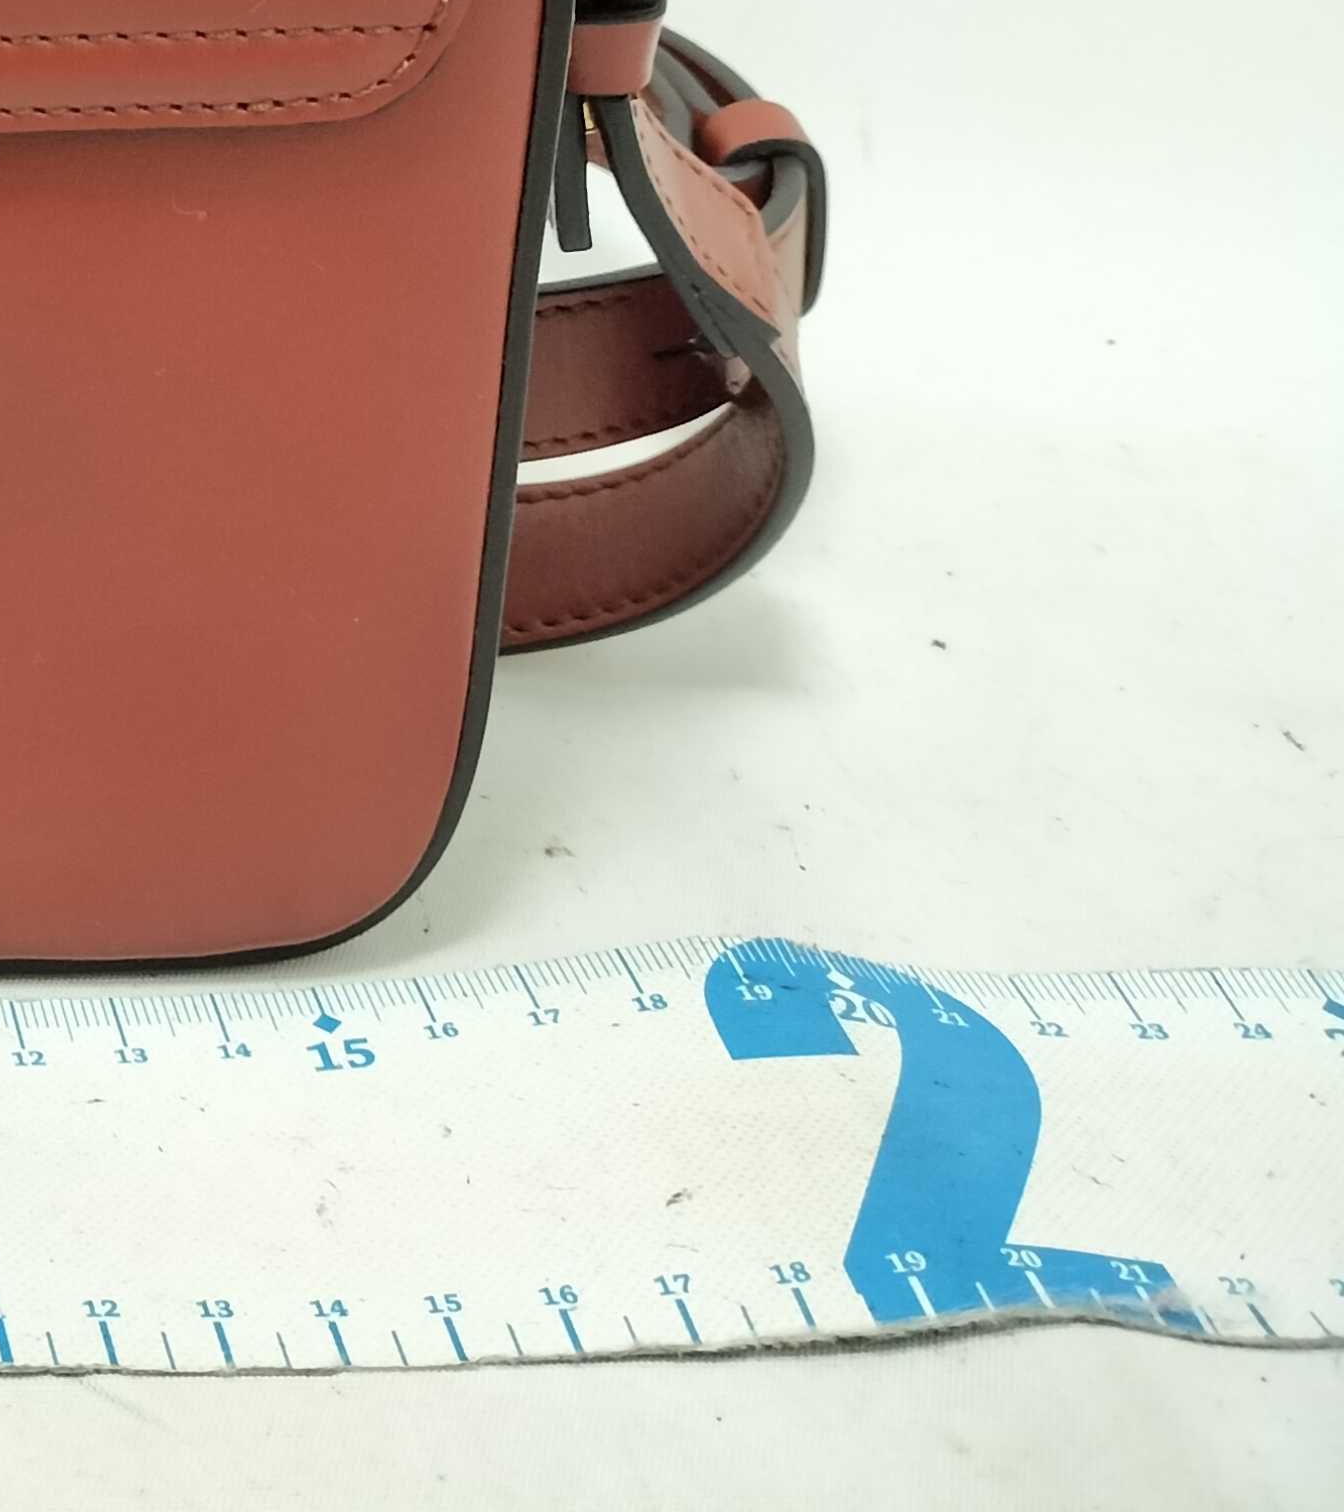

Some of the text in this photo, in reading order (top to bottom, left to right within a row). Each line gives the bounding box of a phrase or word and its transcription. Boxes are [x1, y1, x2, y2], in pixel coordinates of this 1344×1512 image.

[11, 1051, 46, 1066] 12
[114, 1048, 148, 1064] 13
[217, 1043, 252, 1059] 14
[306, 1038, 376, 1072] 15
[424, 1022, 459, 1039] 16
[527, 1008, 560, 1026] 17
[632, 993, 668, 1012] 18
[736, 984, 773, 1000] 19
[826, 990, 897, 1028] 20
[931, 1008, 970, 1027] 21
[1030, 1021, 1071, 1037] 22
[1130, 1023, 1169, 1039] 23
[1233, 1022, 1273, 1039] 24
[704, 937, 1205, 1335] 2
[82, 1300, 120, 1317] 12
[196, 1300, 234, 1318] 13
[309, 1299, 349, 1317] 14
[424, 1293, 462, 1314] 15
[538, 1285, 579, 1306] 16
[653, 1274, 691, 1296] 17
[769, 1261, 811, 1285] 18
[885, 1250, 927, 1273] 19
[1000, 1248, 1042, 1268] 20
[1110, 1260, 1152, 1285] 21
